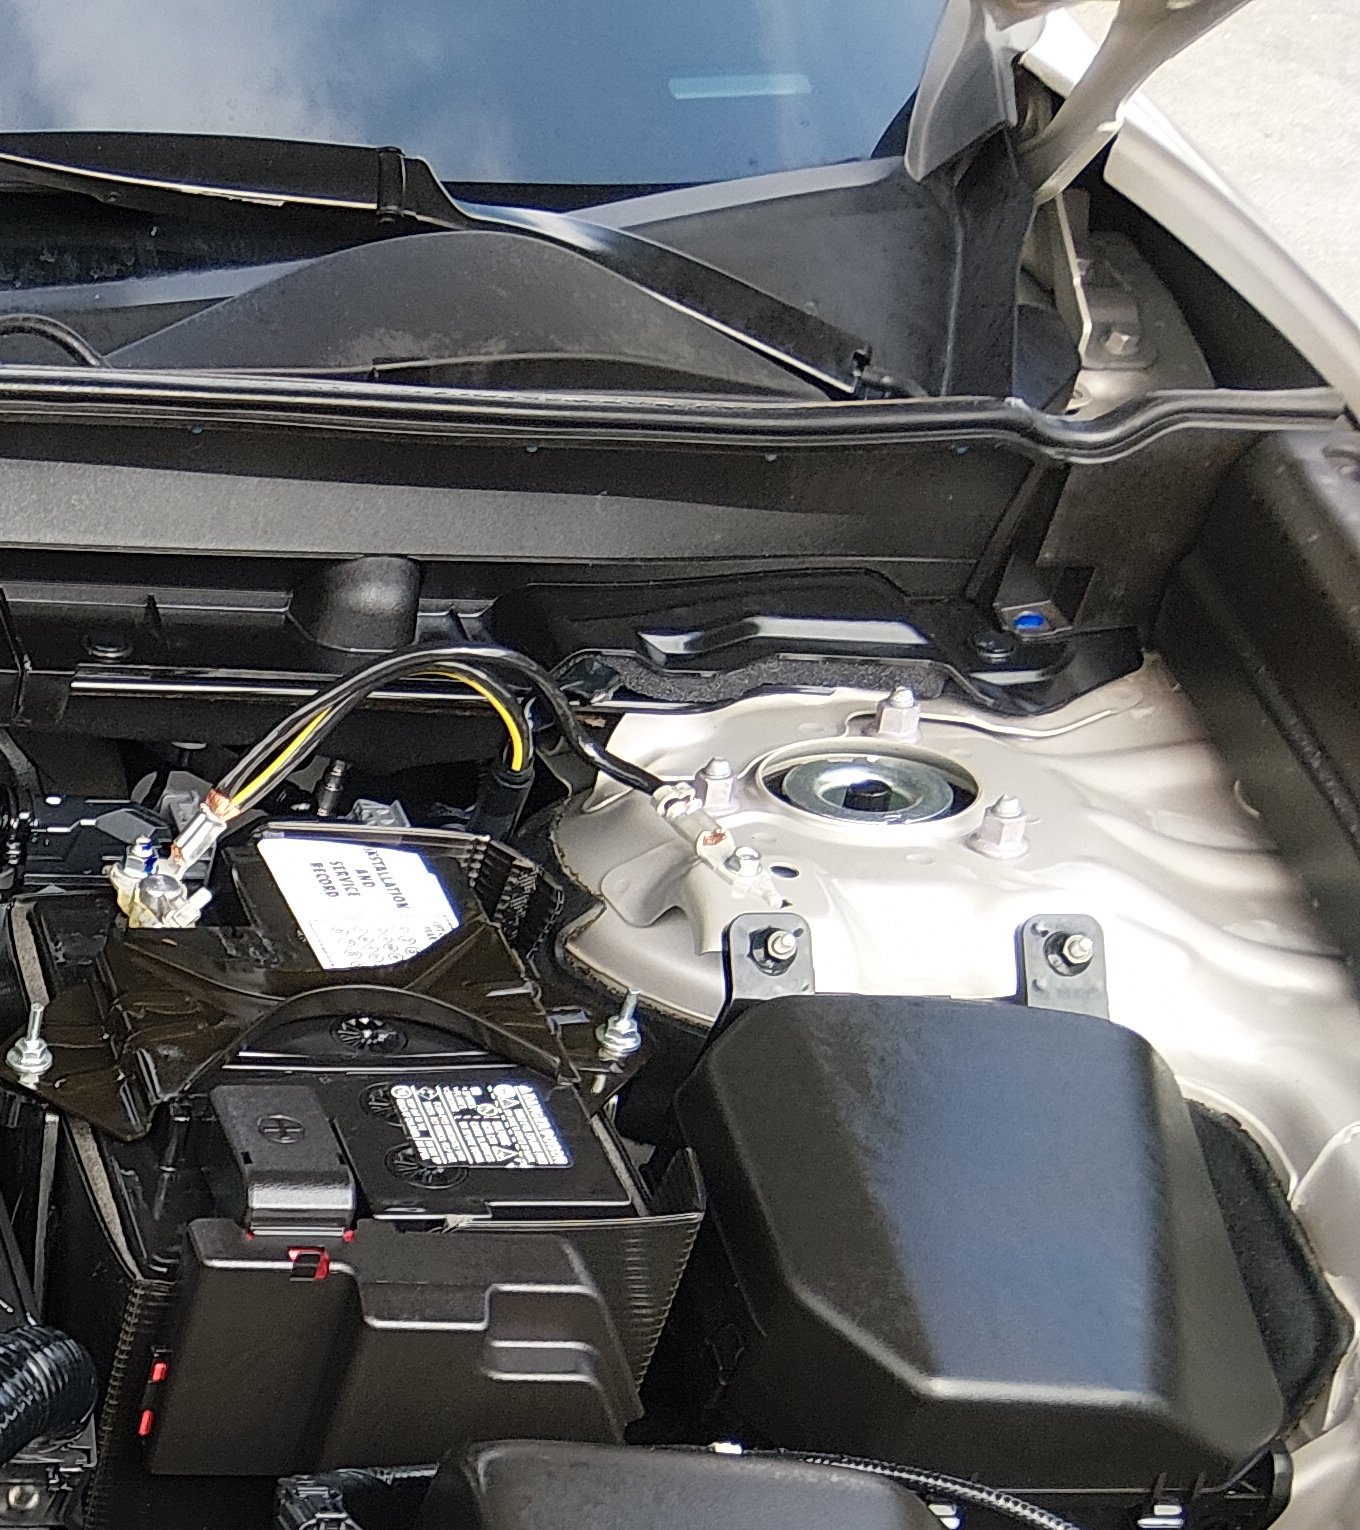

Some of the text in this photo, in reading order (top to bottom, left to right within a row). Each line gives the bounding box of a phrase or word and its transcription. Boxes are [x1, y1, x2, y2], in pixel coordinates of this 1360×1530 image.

[309, 862, 340, 898] RECORD
[329, 860, 360, 897] SERVICE
[354, 869, 376, 888] AND
